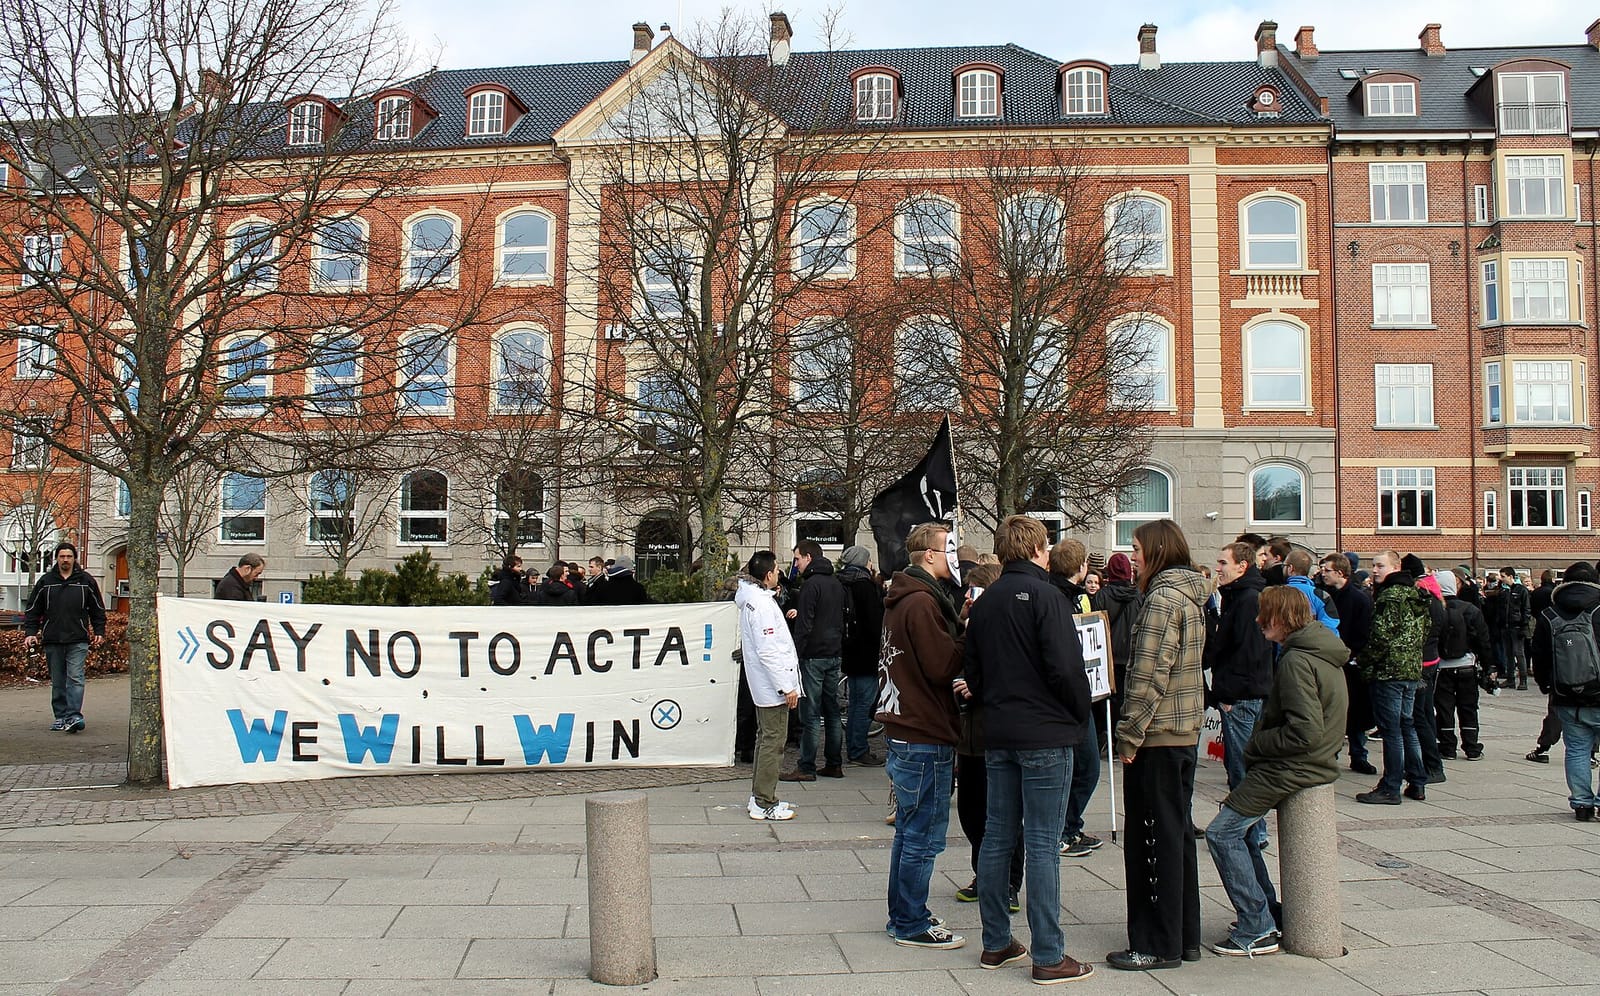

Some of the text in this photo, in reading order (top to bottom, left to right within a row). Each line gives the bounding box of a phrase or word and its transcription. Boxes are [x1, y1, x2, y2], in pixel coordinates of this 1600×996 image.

[283, 594, 290, 604] P
[206, 619, 712, 679] SAY NO TO ACTA!
[1087, 667, 1104, 691] TA
[225, 709, 640, 766] WE WILL WIN
